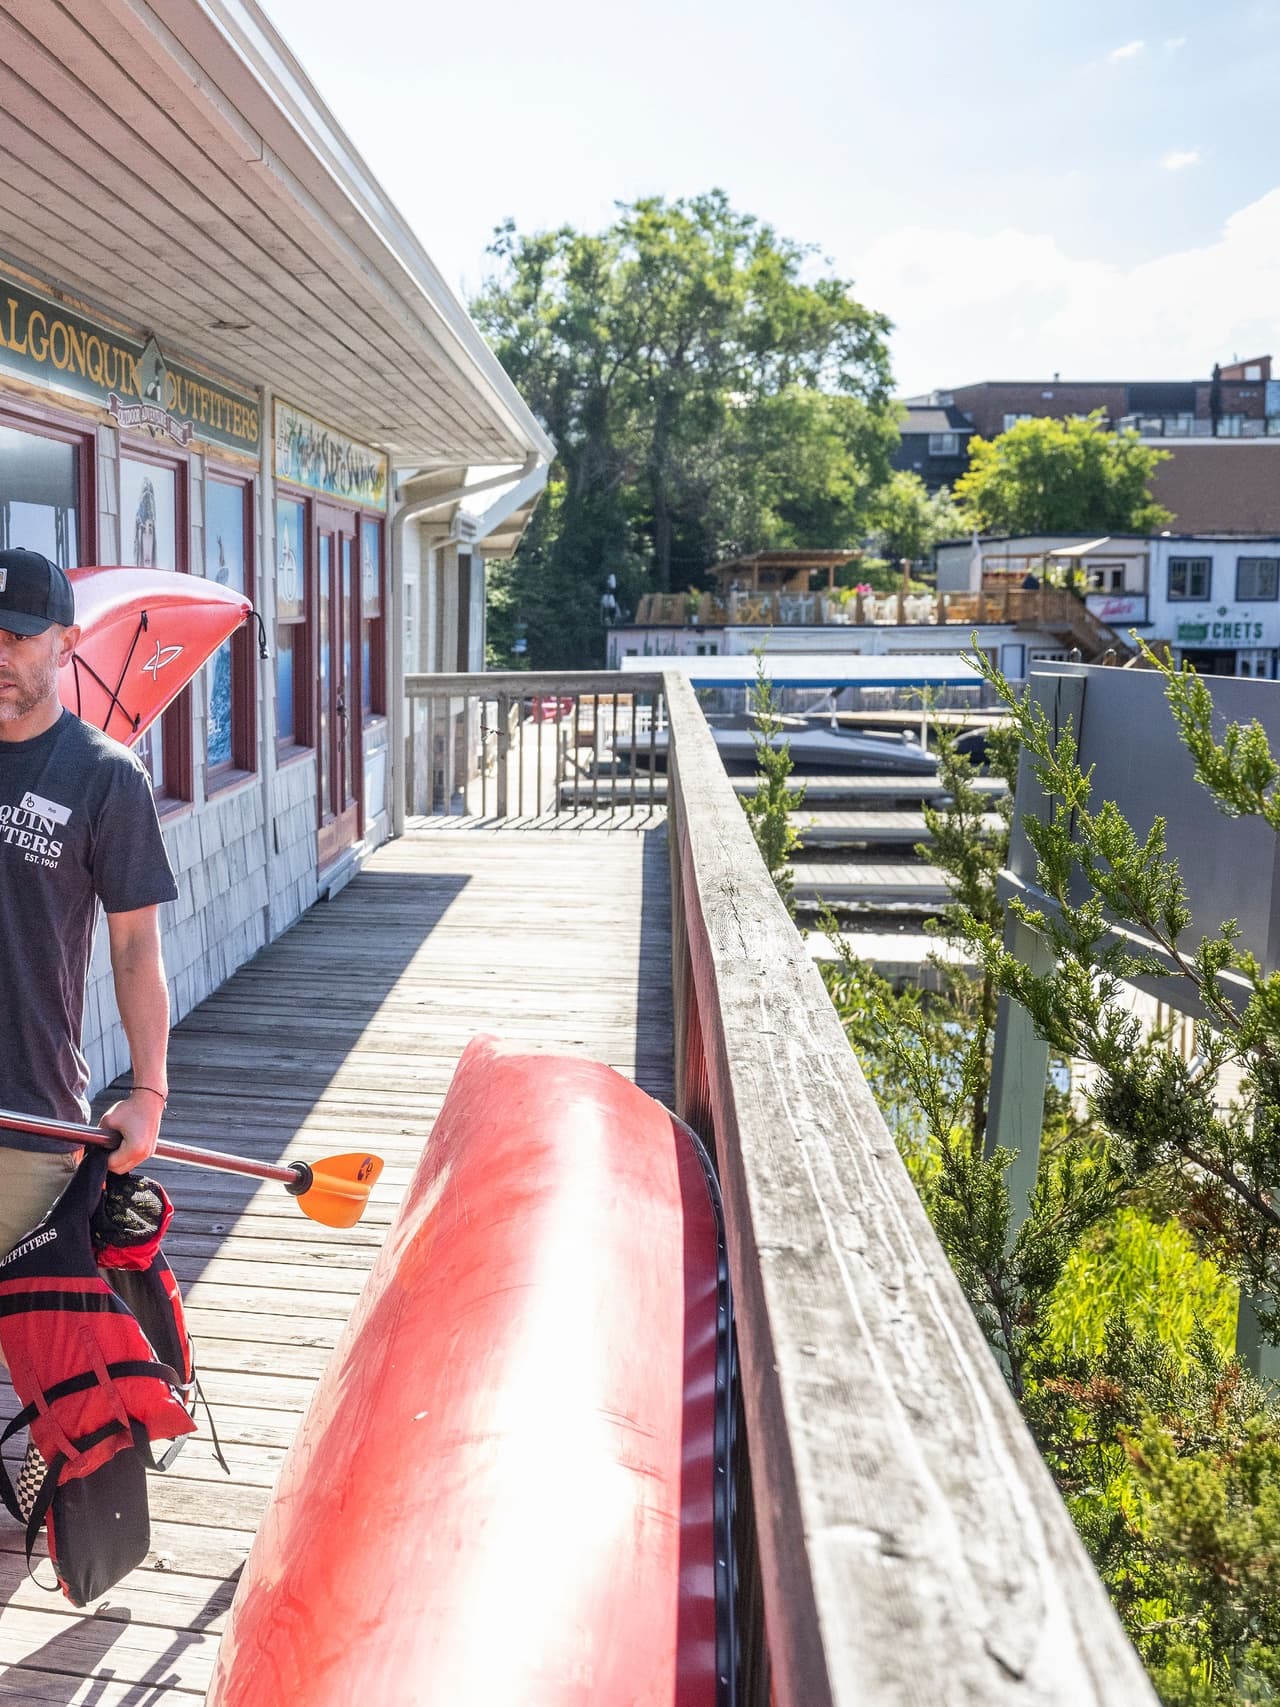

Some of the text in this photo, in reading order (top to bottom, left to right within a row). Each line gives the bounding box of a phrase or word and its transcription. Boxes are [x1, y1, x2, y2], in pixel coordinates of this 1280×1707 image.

[165, 369, 260, 444] OUTFITTERS
[1204, 622, 1263, 639] CHETS
[24, 853, 59, 870] EST. 1961
